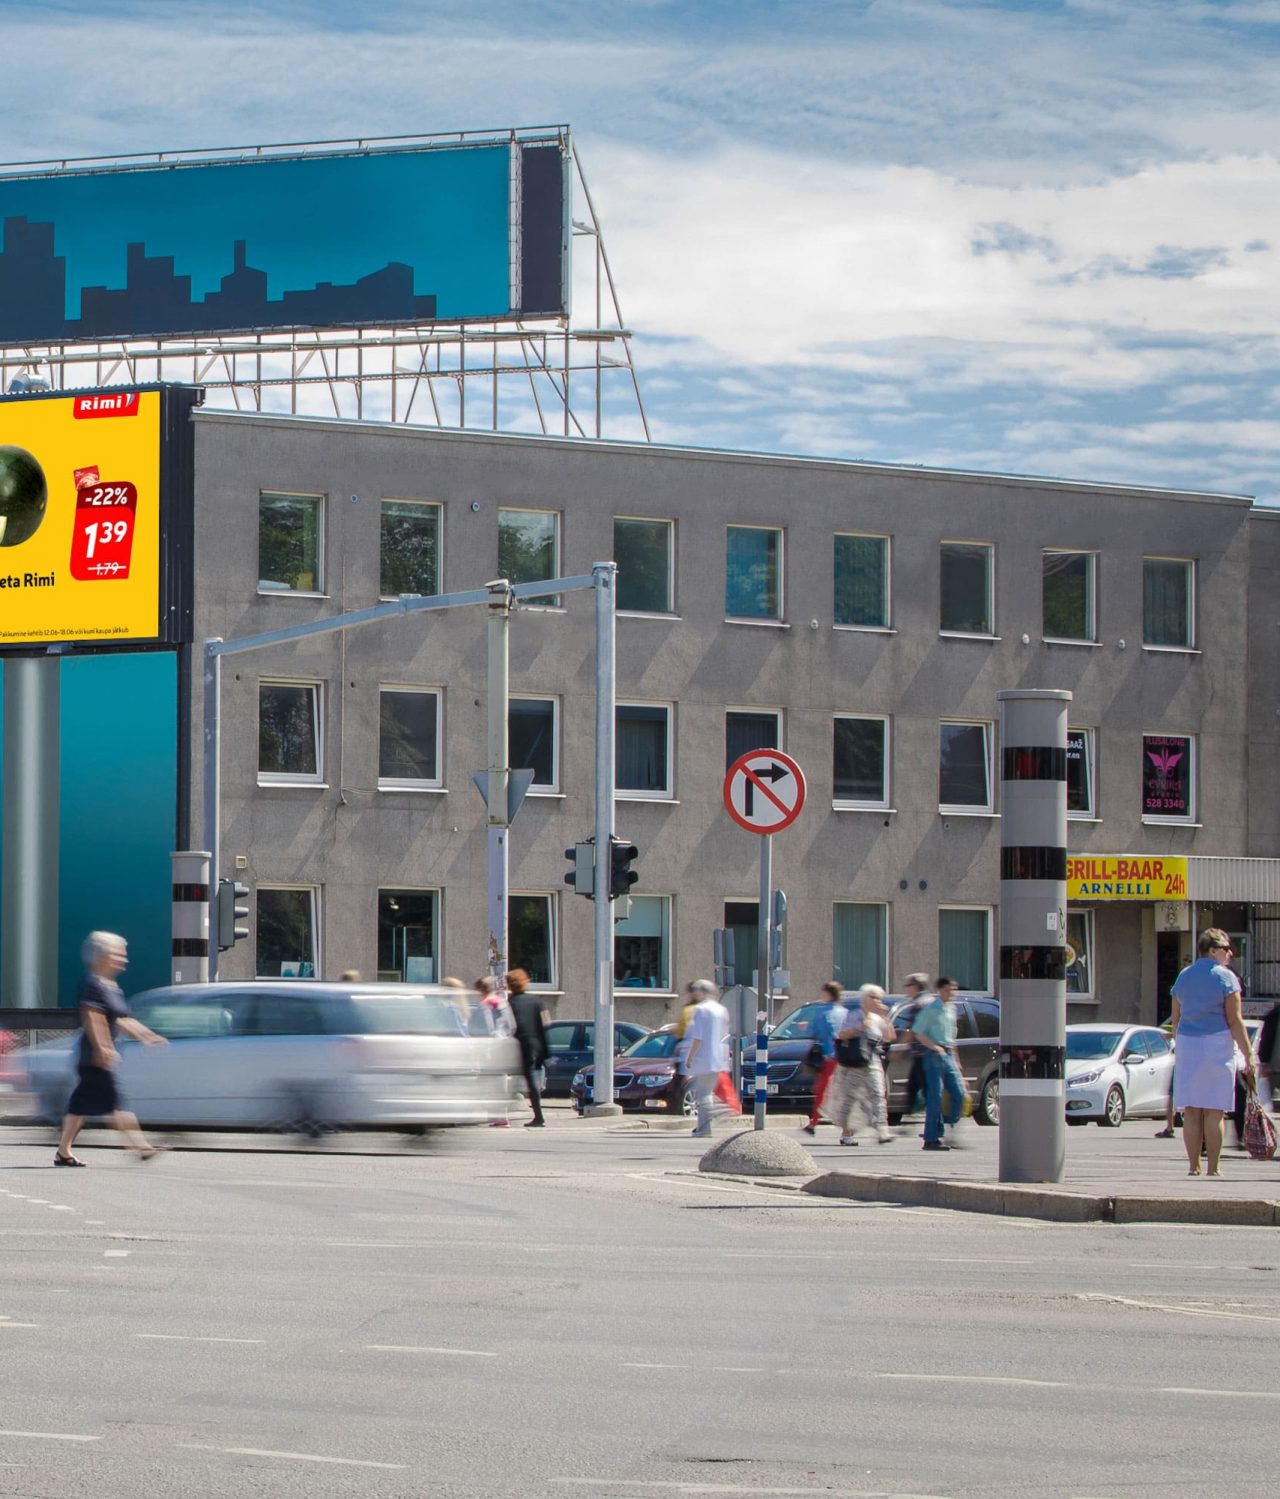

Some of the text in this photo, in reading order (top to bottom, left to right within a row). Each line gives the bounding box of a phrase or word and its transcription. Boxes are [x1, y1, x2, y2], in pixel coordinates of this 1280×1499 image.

[80, 395, 123, 411] Rimi
[85, 487, 128, 506] -22%
[24, 571, 55, 588] Rimi
[1146, 798, 1162, 808] 528
[1066, 860, 1164, 881] GRILL-BAAR
[1080, 883, 1151, 895] ARNELLI
[1165, 873, 1185, 895] 24h
